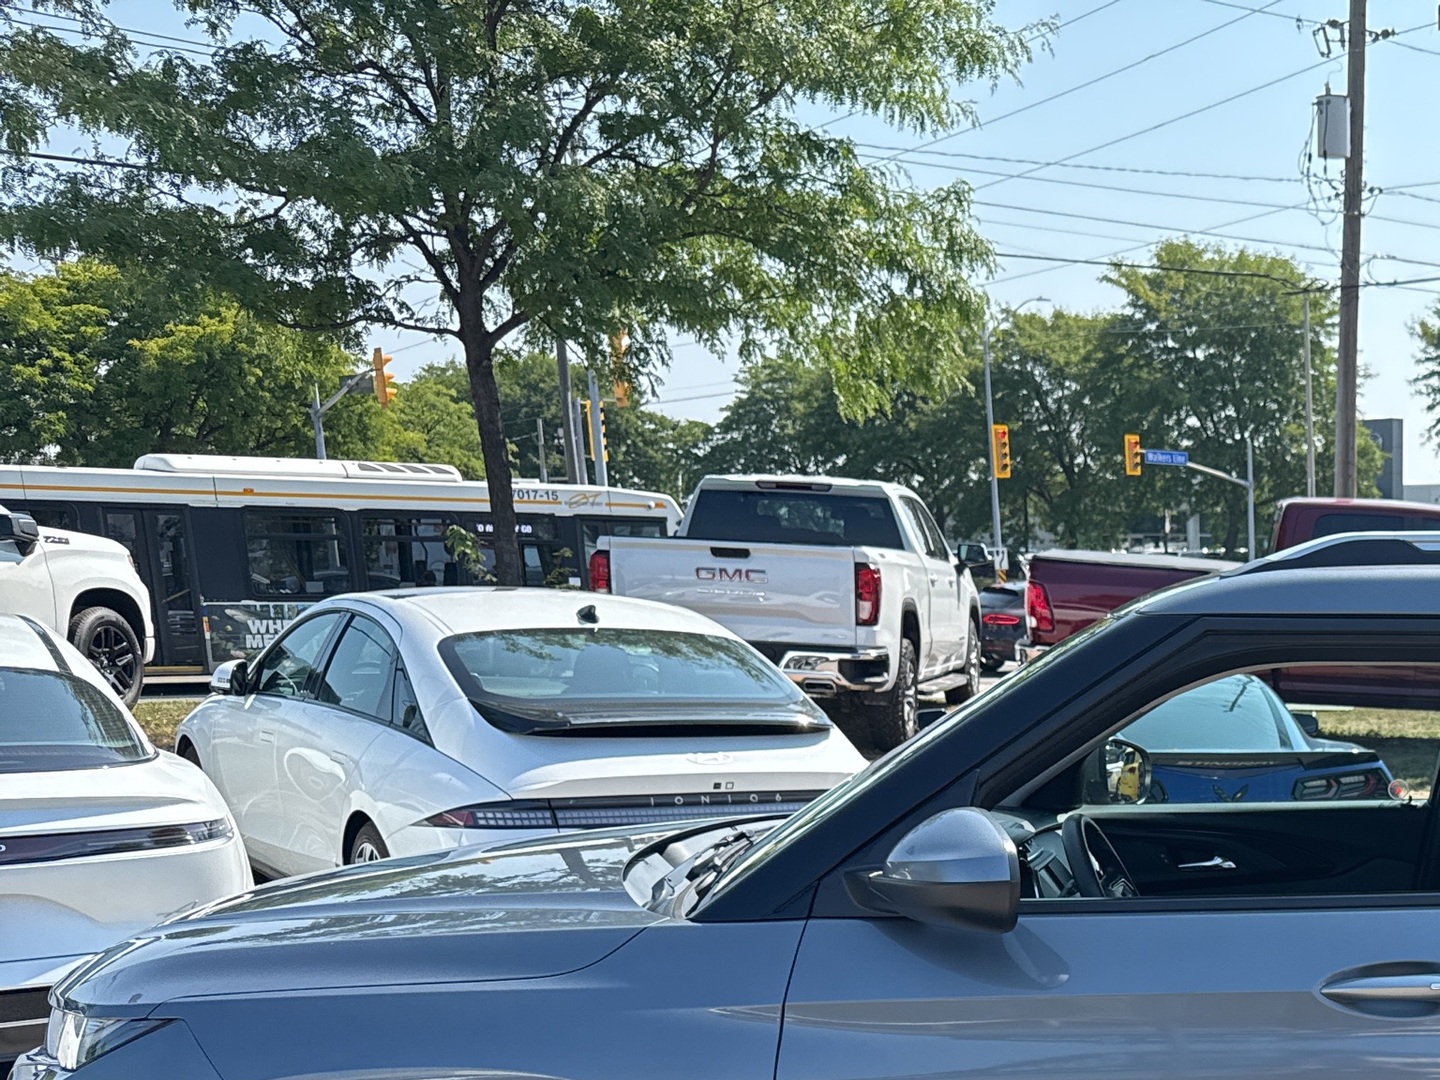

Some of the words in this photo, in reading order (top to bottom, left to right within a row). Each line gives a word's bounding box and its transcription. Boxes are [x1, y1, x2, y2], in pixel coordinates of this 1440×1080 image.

[695, 567, 768, 584] GMC
[245, 634, 279, 649] ME
[650, 792, 759, 807] IONIQ
[775, 792, 783, 802] 6
